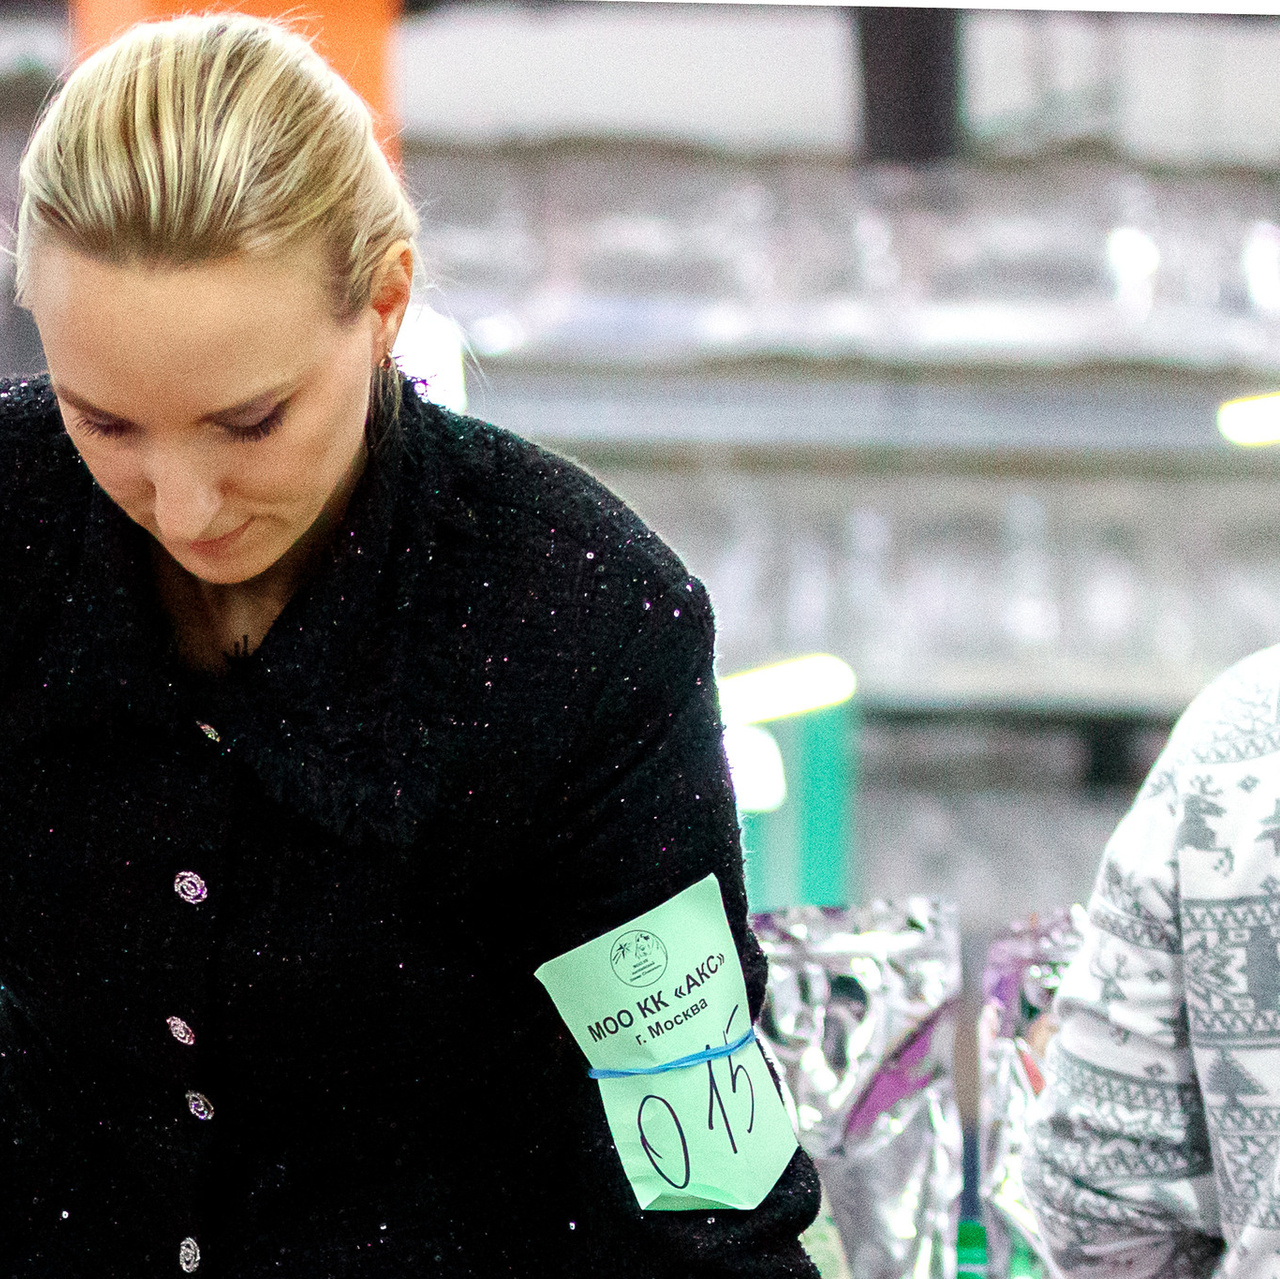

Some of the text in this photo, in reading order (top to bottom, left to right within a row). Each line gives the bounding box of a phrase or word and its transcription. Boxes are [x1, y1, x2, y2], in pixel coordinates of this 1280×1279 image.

[587, 1008, 634, 1043] МОО
[637, 990, 670, 1021] КК
[673, 953, 726, 1001] «АКС»
[635, 998, 709, 1046] г. Москва
